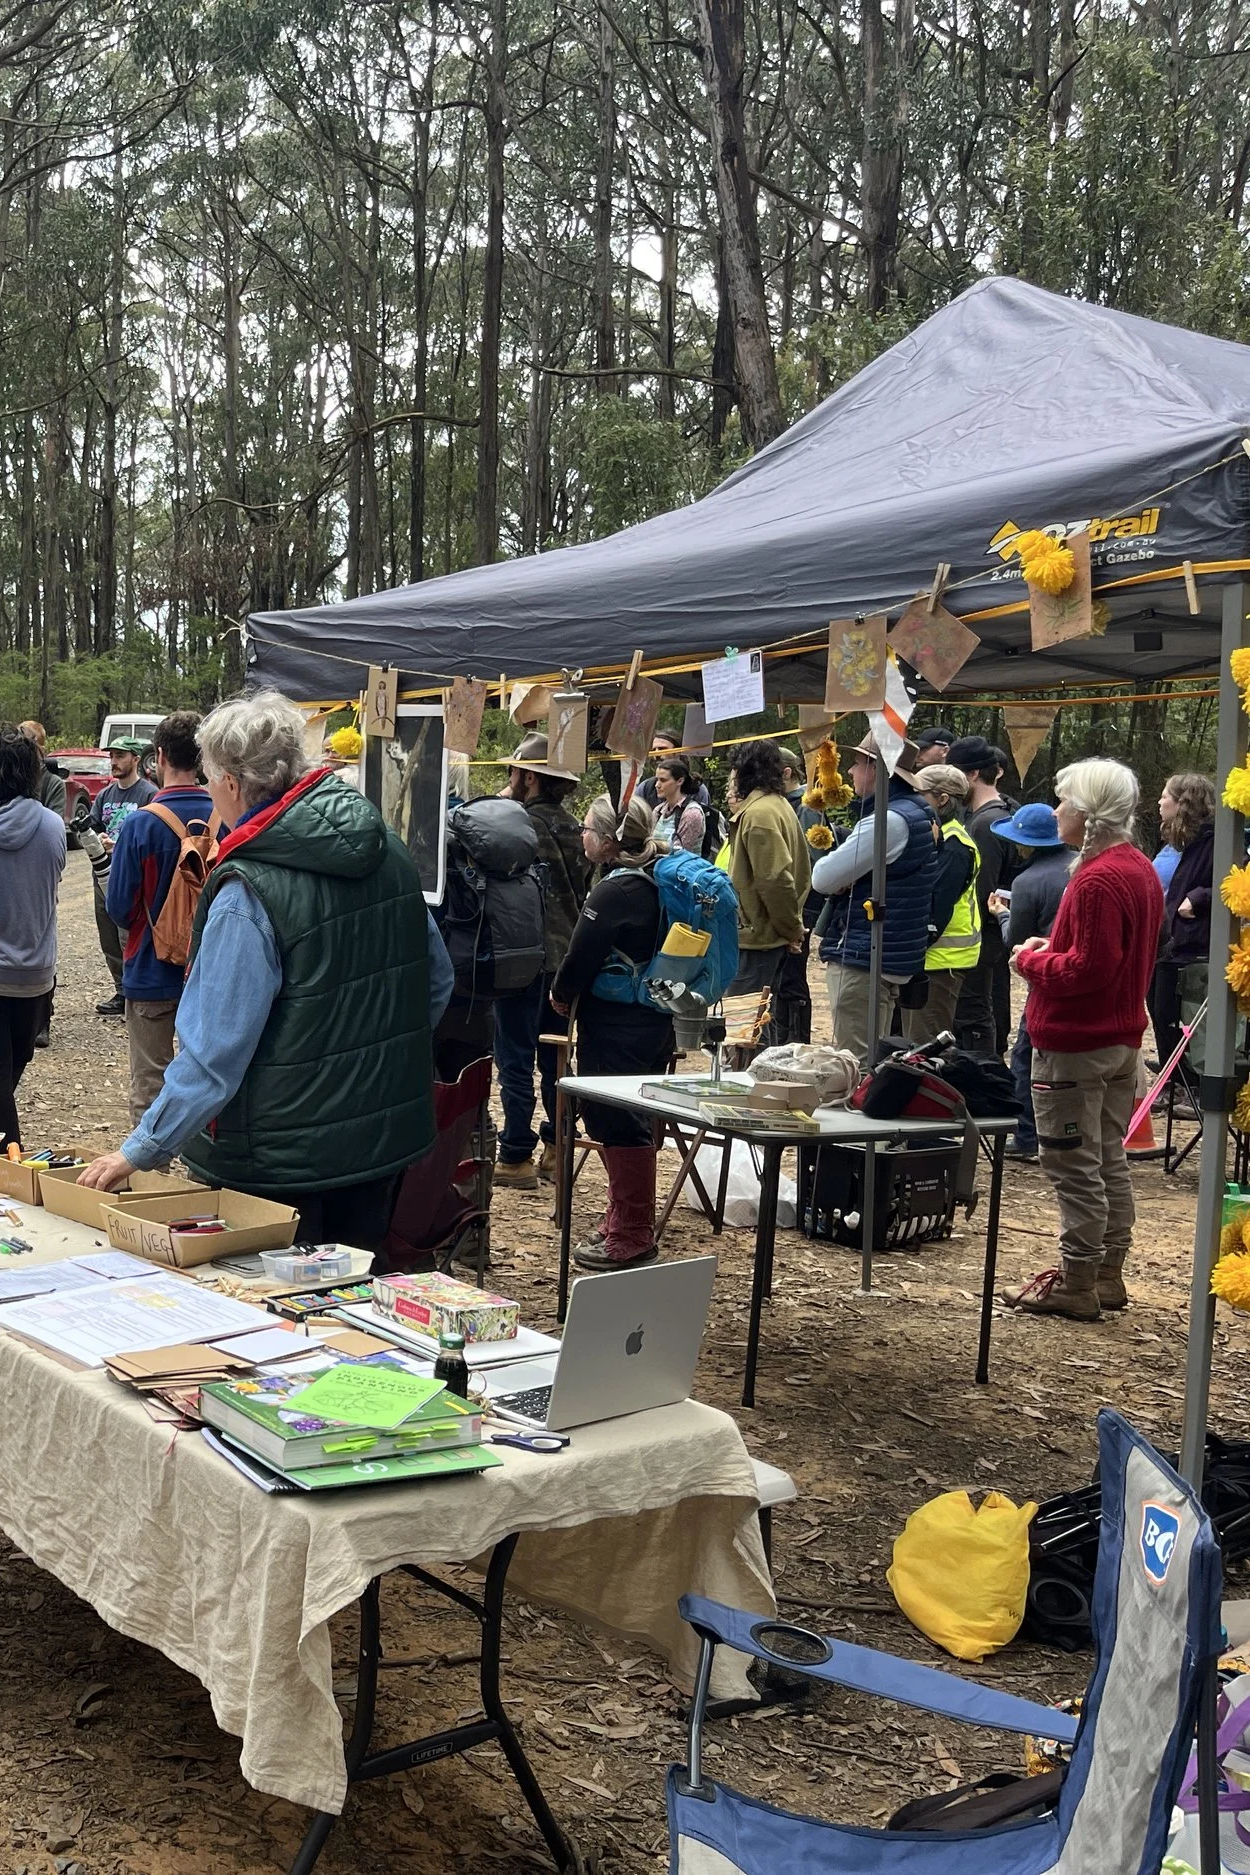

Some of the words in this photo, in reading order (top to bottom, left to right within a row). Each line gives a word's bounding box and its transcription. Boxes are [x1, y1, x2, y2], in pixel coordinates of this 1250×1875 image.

[990, 569, 1022, 581] 2.4m
[1106, 549, 1155, 565] Gazebo
[336, 1376, 418, 1395] PLANTING
[337, 1372, 426, 1393] INDIGENOUS
